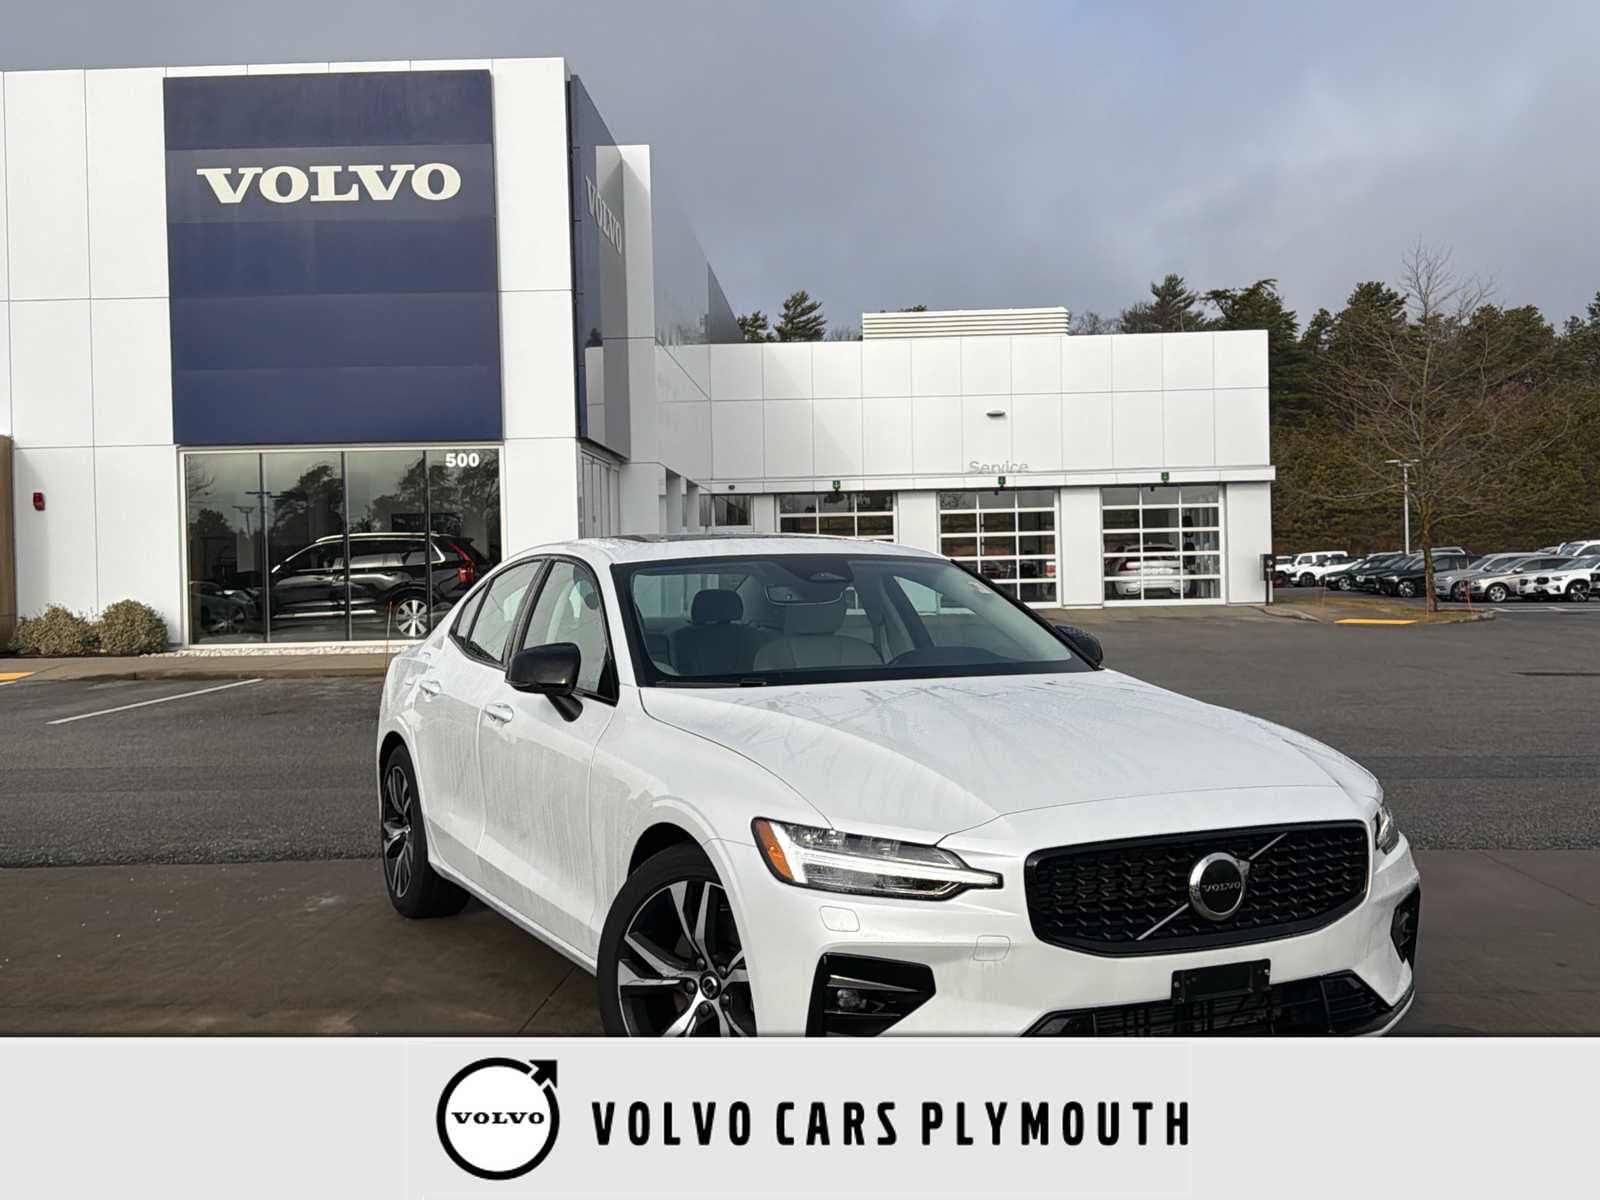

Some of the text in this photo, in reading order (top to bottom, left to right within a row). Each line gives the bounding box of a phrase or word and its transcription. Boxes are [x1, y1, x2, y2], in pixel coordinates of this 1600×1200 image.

[196, 162, 462, 204] VOLVO
[585, 175, 622, 255] VOLVO
[445, 452, 480, 468] 500
[968, 460, 1029, 474] Service
[1202, 881, 1241, 893] VOLVO
